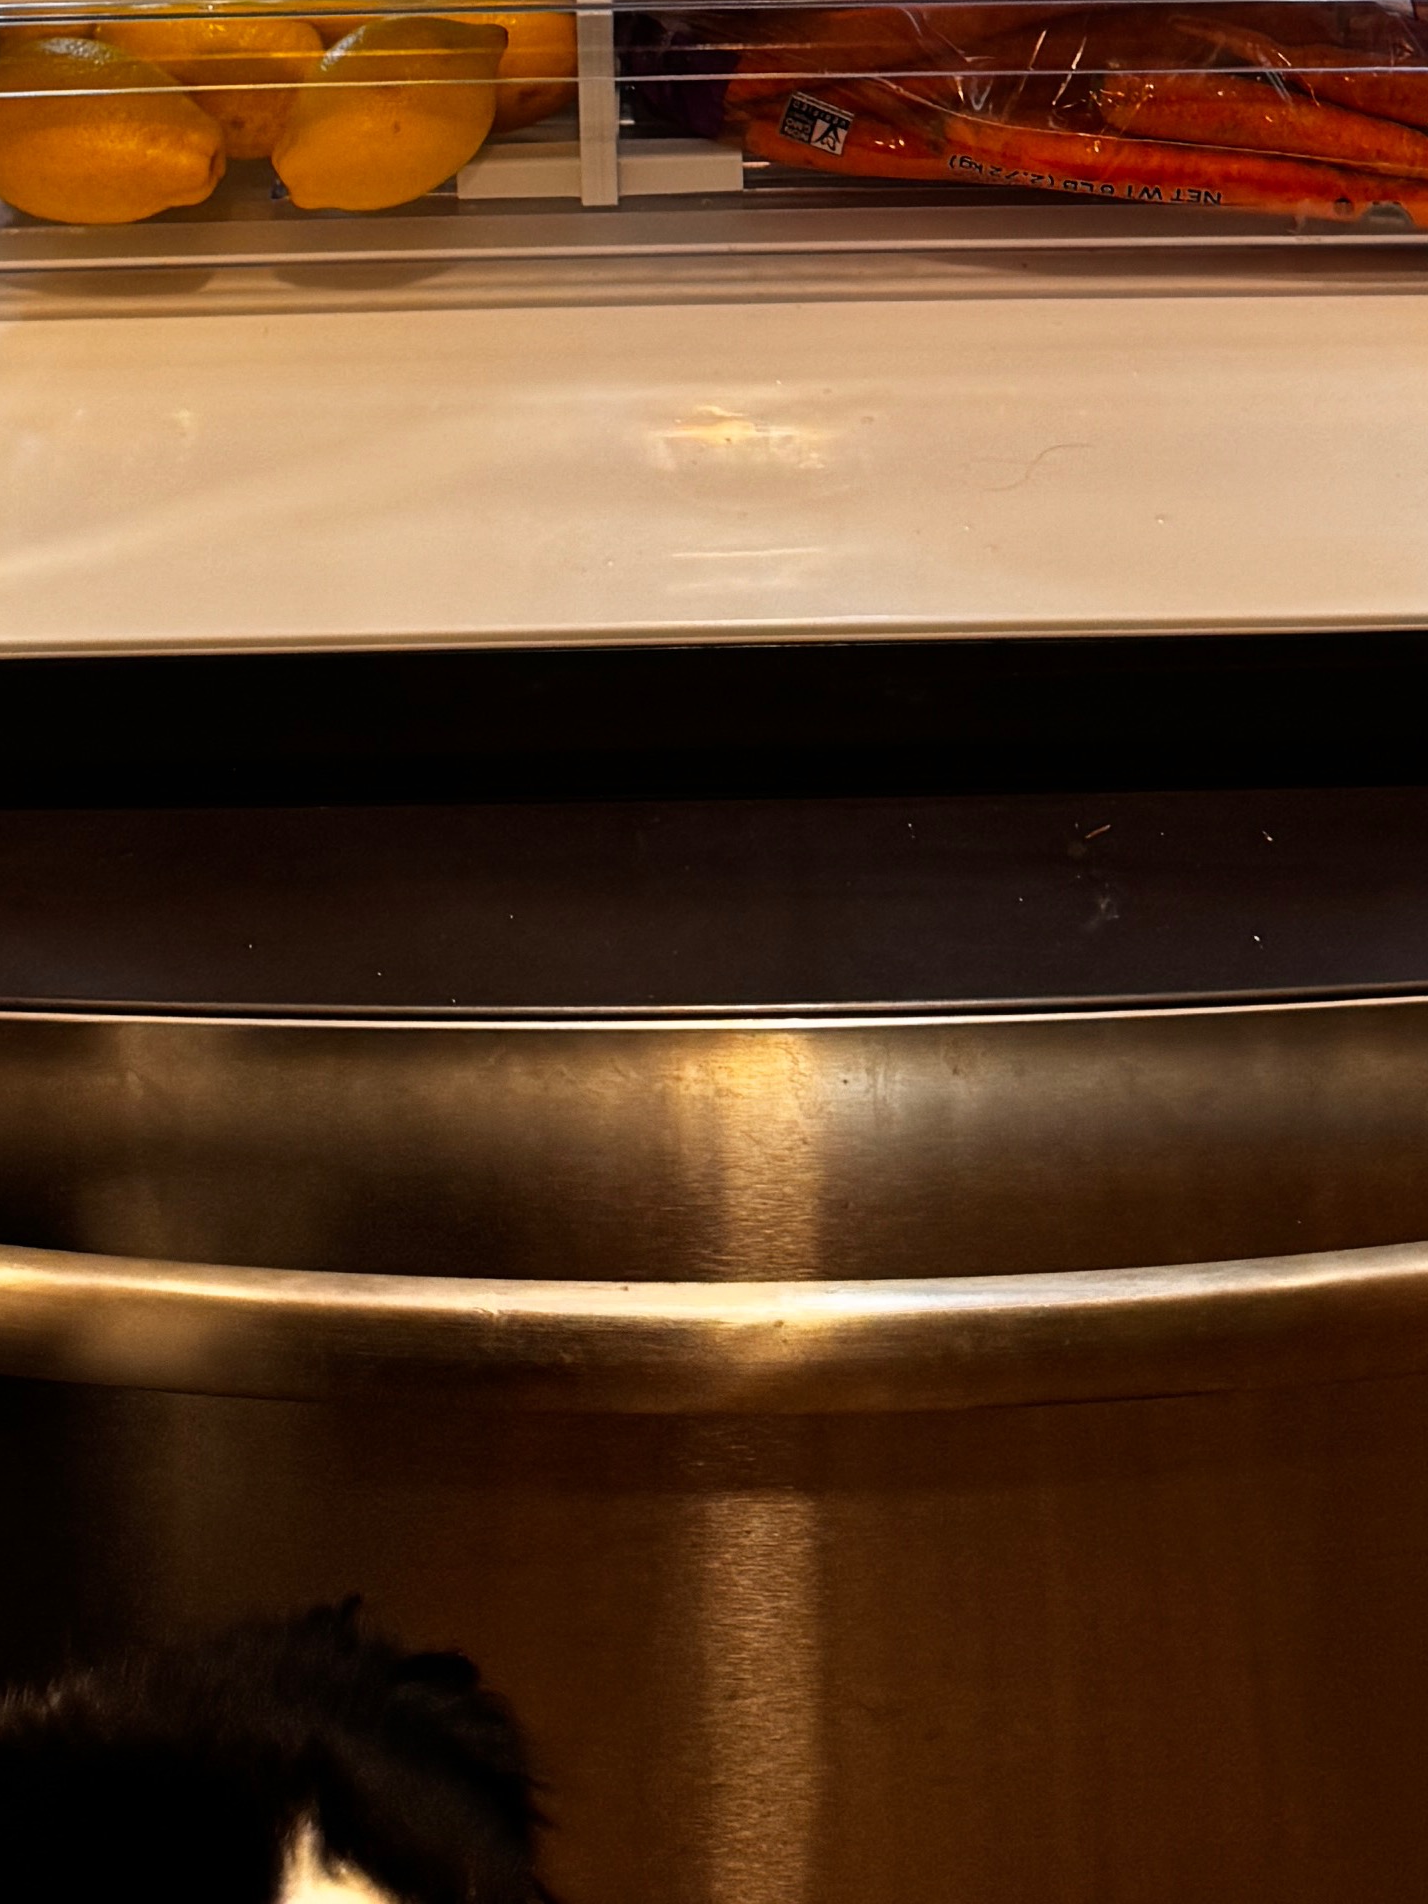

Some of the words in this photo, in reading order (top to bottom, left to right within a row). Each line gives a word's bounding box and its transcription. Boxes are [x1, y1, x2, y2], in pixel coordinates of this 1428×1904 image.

[948, 153, 984, 172] kg)
[1063, 178, 1091, 194] LB
[1171, 188, 1223, 206] NET
